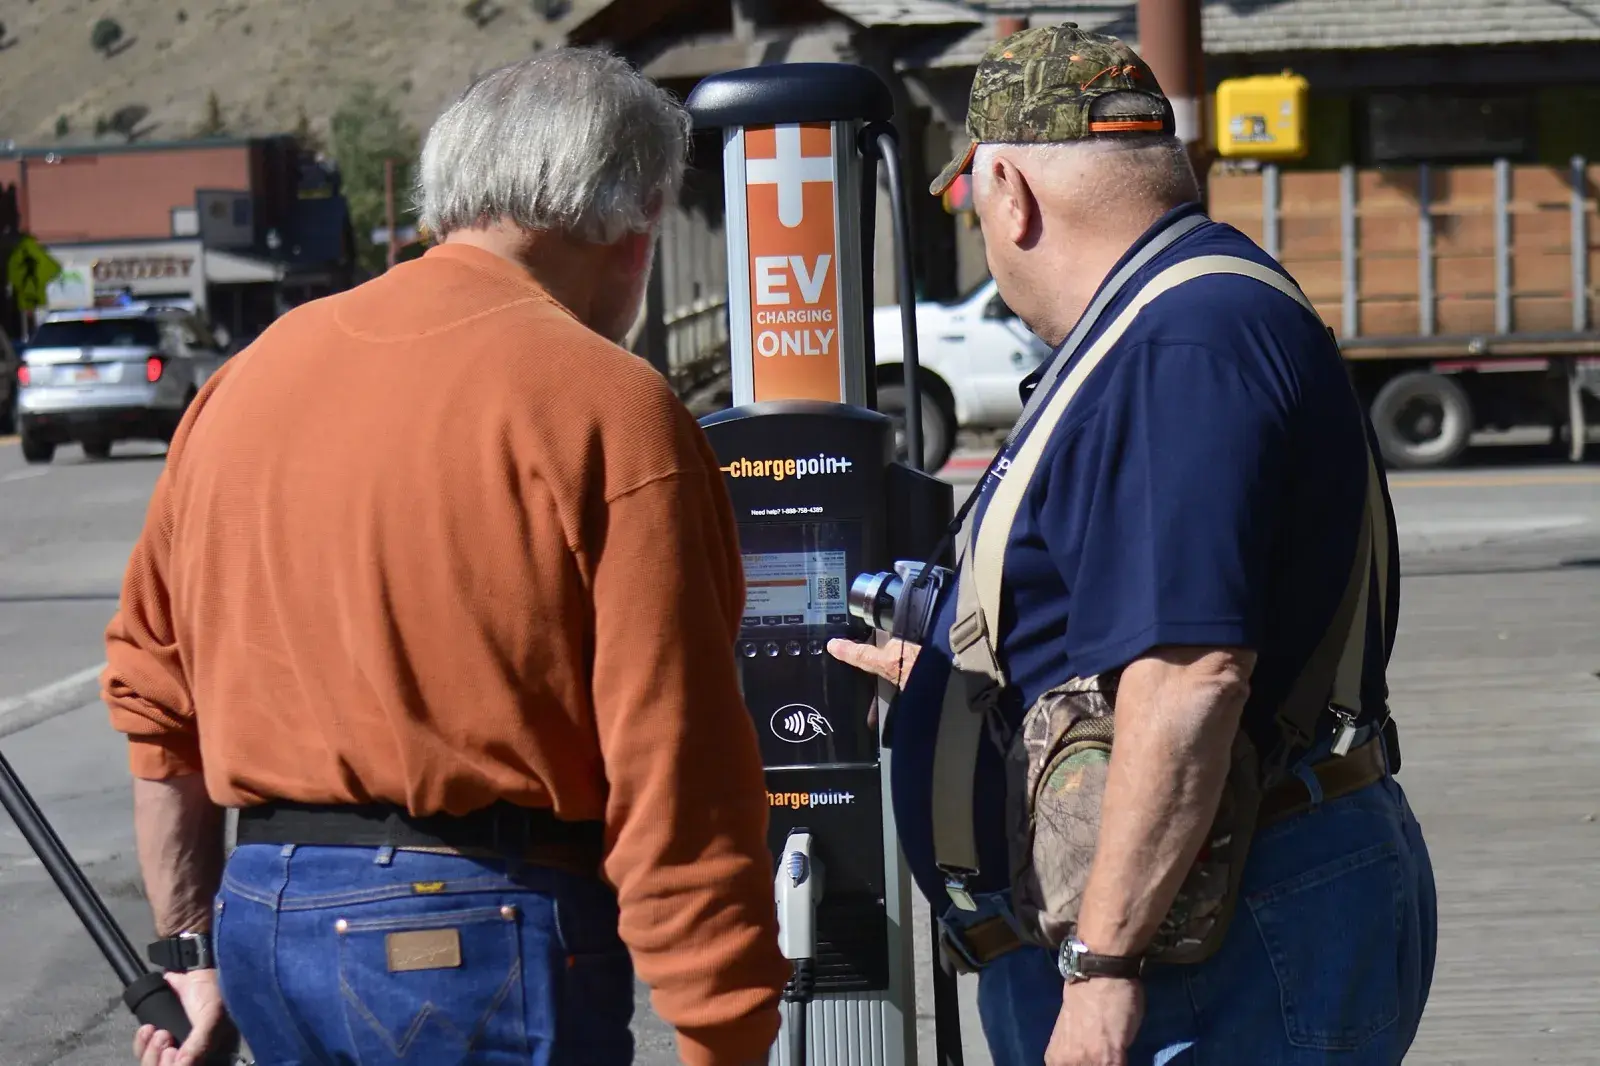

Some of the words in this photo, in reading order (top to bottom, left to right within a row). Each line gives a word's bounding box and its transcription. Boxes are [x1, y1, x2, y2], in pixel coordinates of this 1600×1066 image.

[755, 254, 832, 305] EV
[756, 309, 832, 324] CHARGING
[757, 328, 835, 357] ONLY
[765, 788, 855, 810] hargepoint
